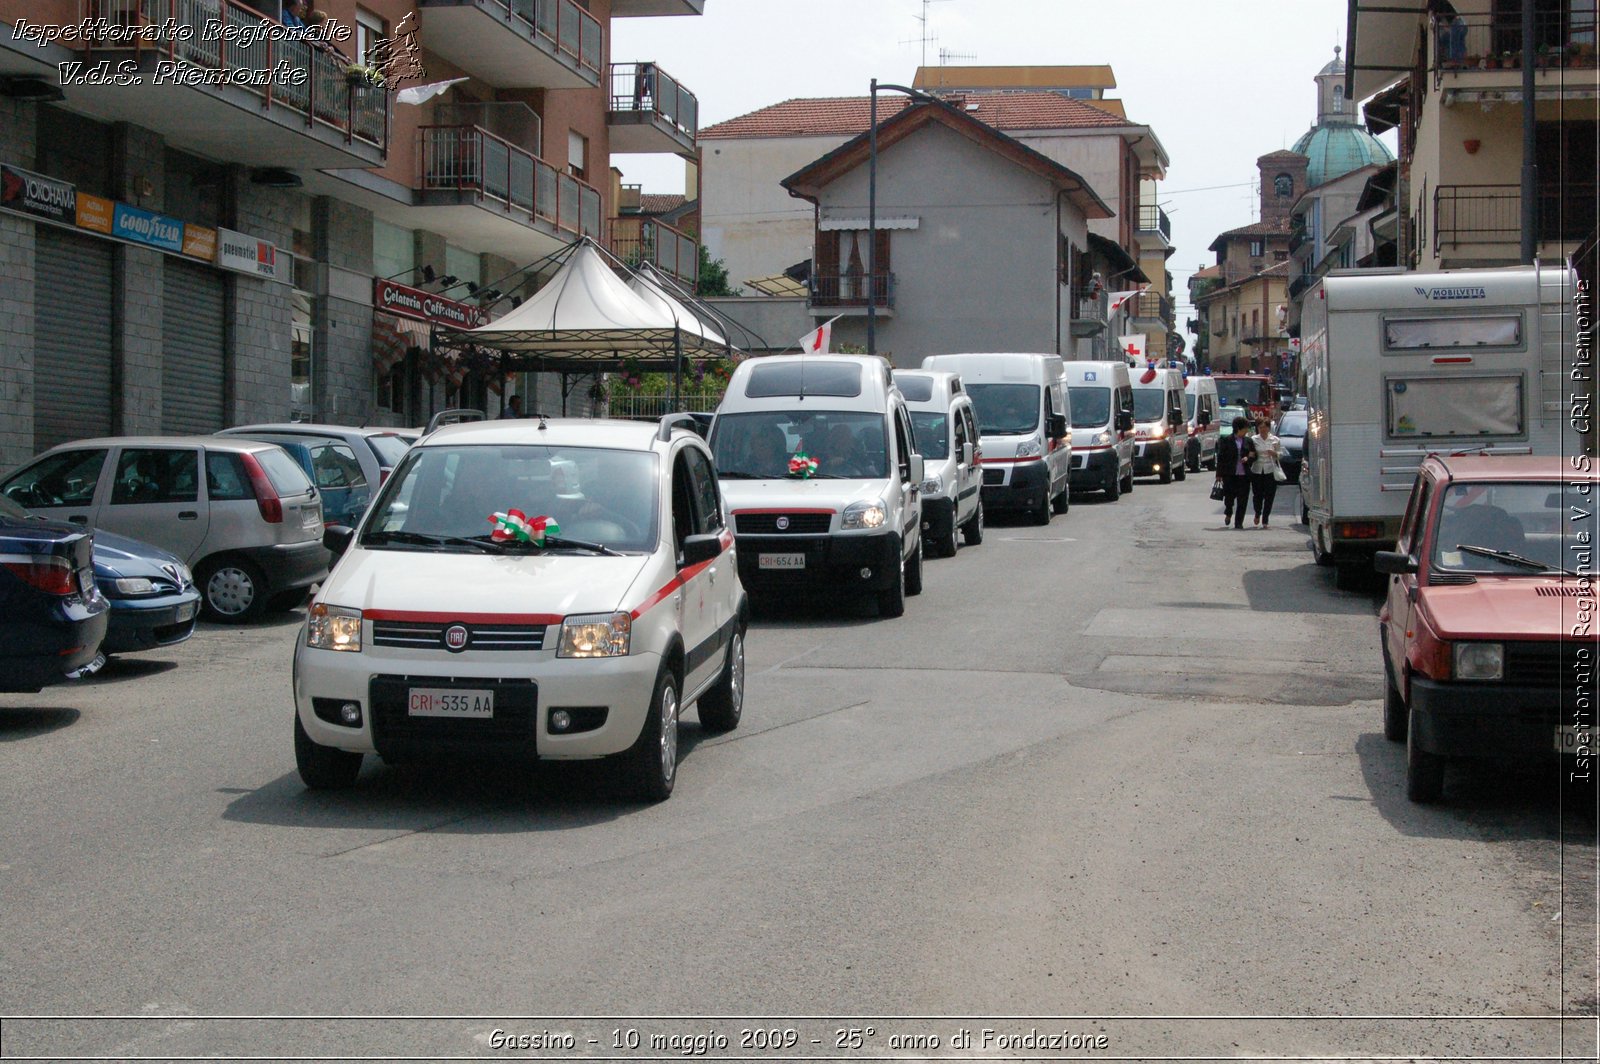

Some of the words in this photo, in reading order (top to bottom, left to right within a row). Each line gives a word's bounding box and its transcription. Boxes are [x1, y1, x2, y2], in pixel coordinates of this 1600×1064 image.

[24, 178, 76, 210] YOKOHAMA
[120, 213, 180, 242] GOODYEAR
[383, 287, 421, 308] Gelateria
[1433, 287, 1486, 297] MOBILVETTA
[450, 632, 464, 643] FIAT
[410, 694, 433, 711] CRI
[441, 695, 469, 712] 535
[473, 696, 491, 712] AA
